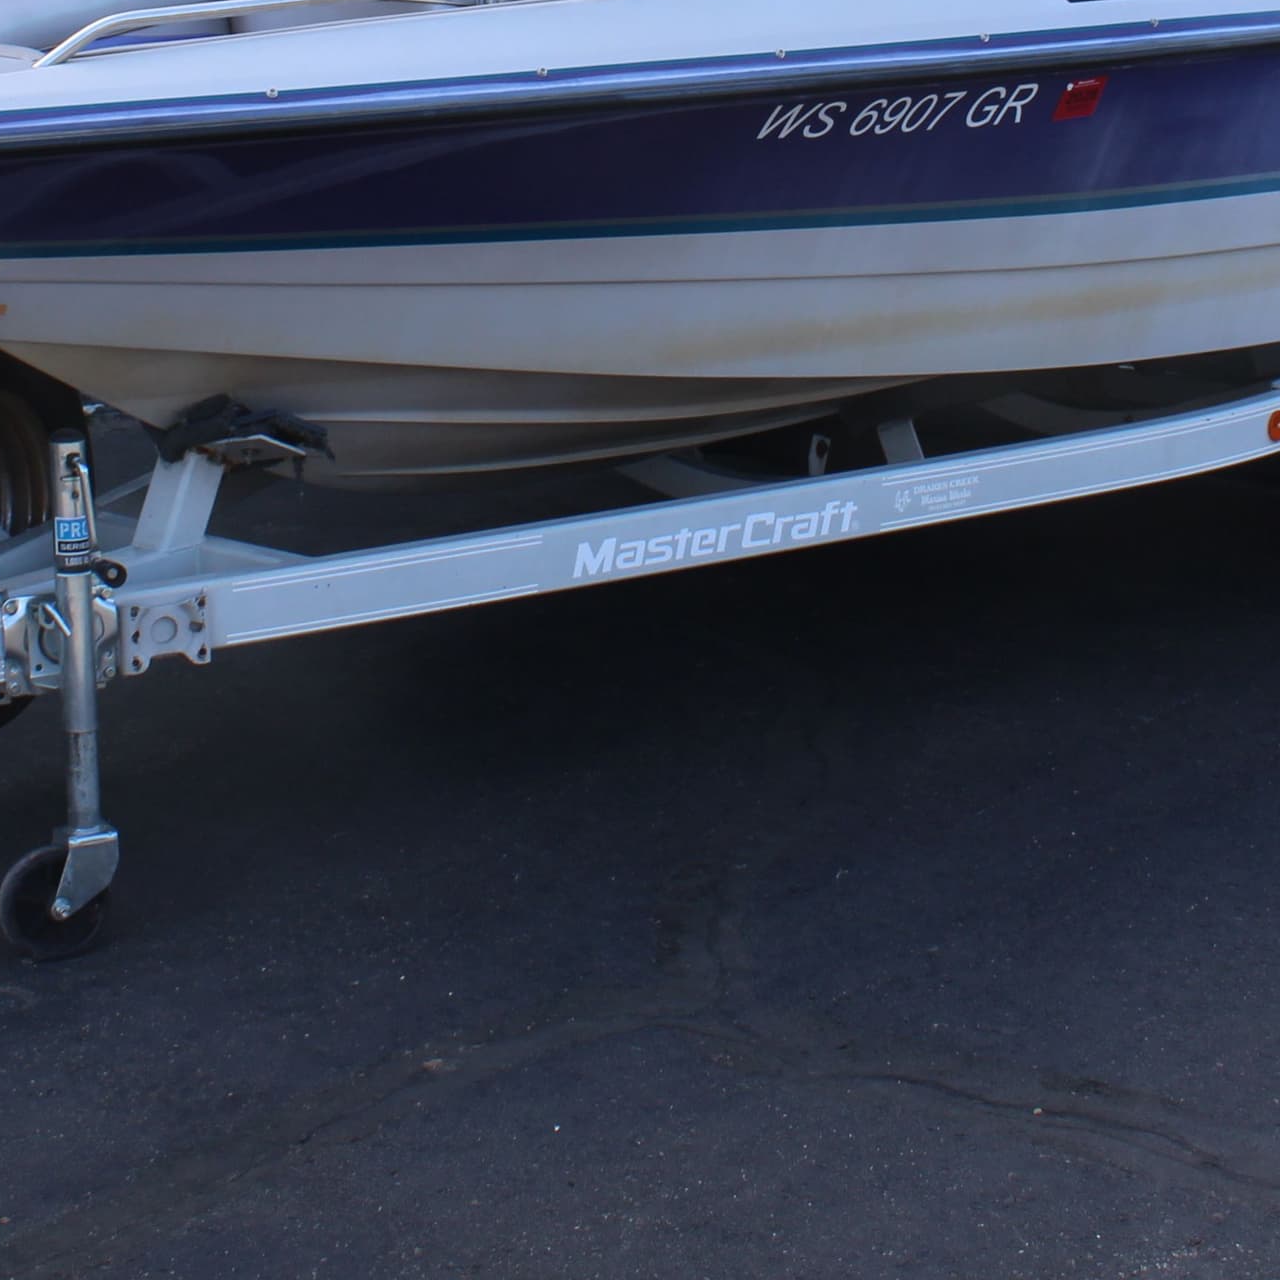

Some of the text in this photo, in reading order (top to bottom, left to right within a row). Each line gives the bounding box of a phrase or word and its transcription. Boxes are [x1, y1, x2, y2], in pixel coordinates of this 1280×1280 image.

[756, 101, 848, 140] WS
[849, 91, 967, 136] 6907
[965, 83, 1040, 128] GR
[572, 500, 858, 578] MasterCraft
